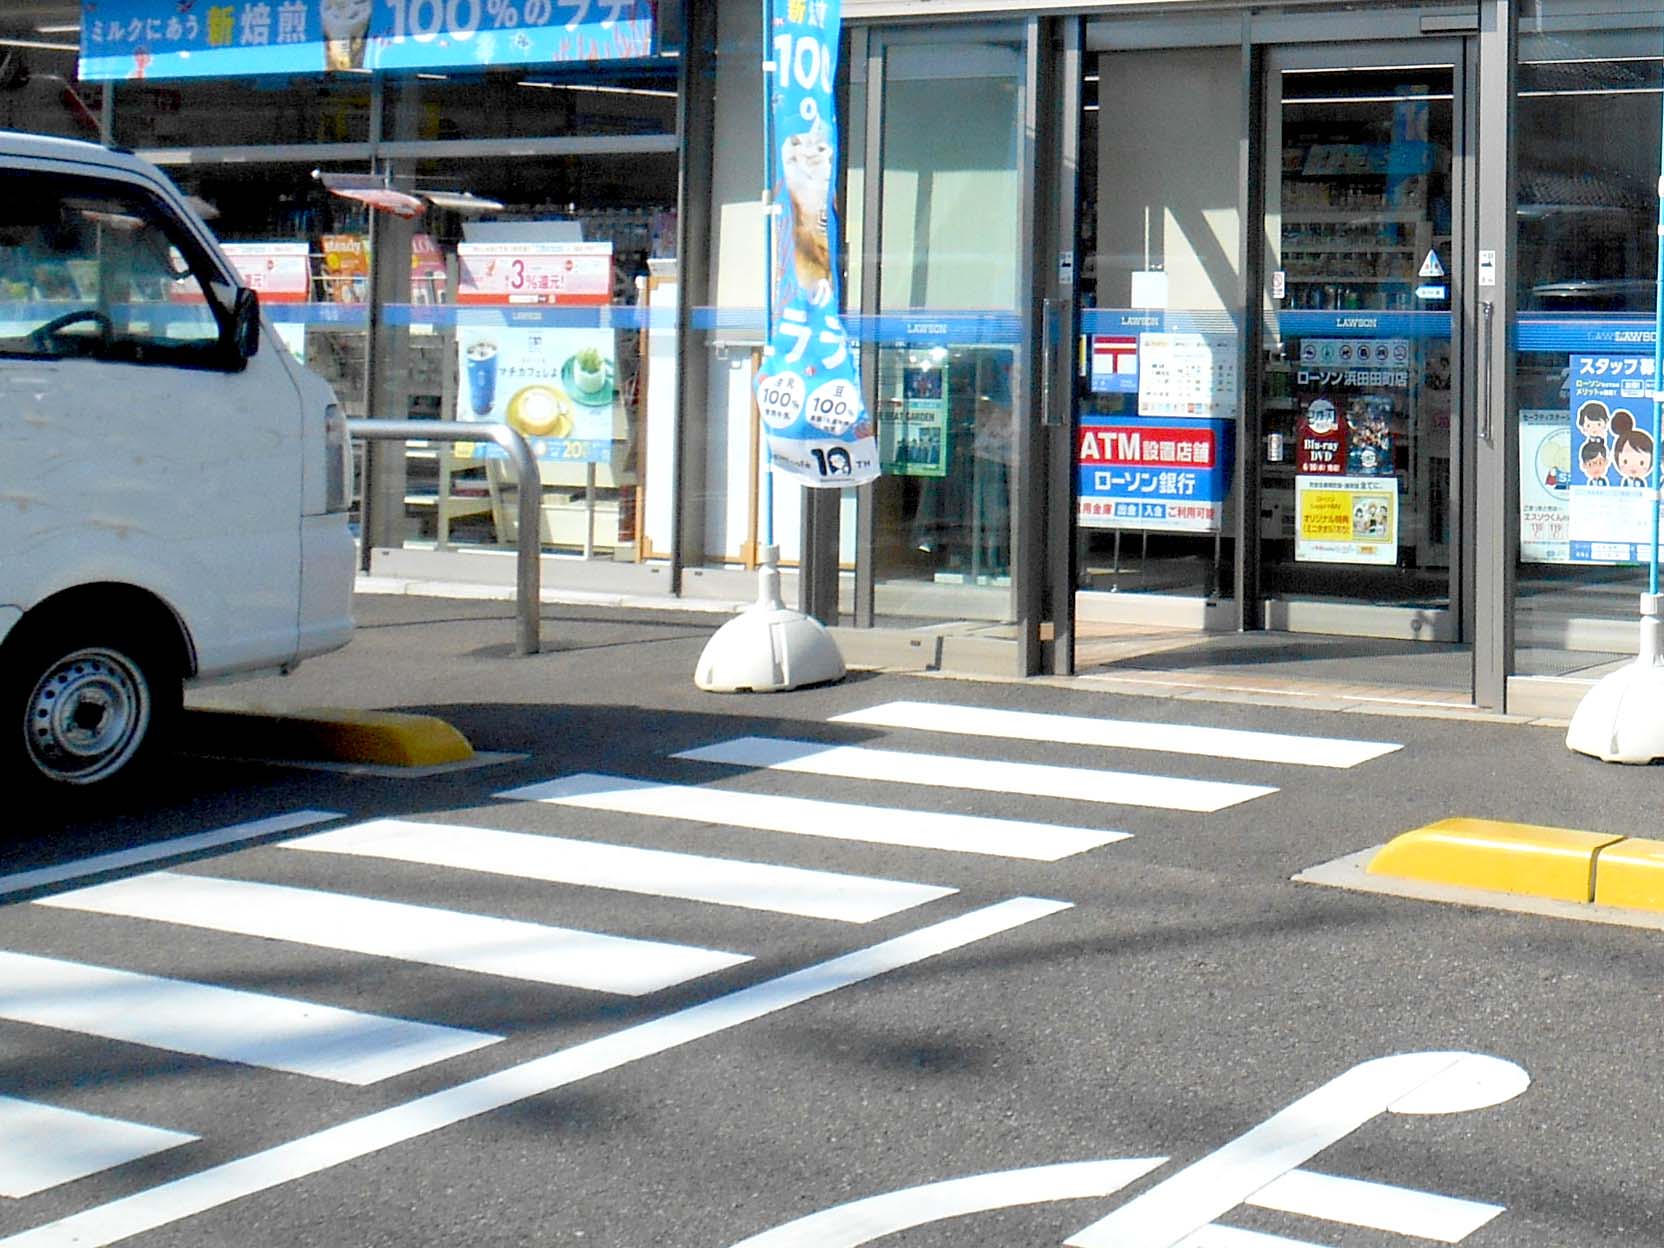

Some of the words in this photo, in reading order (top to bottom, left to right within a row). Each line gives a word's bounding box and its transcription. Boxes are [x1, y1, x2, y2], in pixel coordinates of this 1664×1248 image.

[91, 14, 200, 43] ミルクにあう
[205, 0, 309, 47] 新焙煎
[1336, 318, 1377, 328] LAWSON
[1080, 432, 1210, 463] ATM設置店舗
[1304, 439, 1339, 452] Blu-ray
[1310, 451, 1333, 463] DVD
[1094, 471, 1196, 495] ローソン銀行
